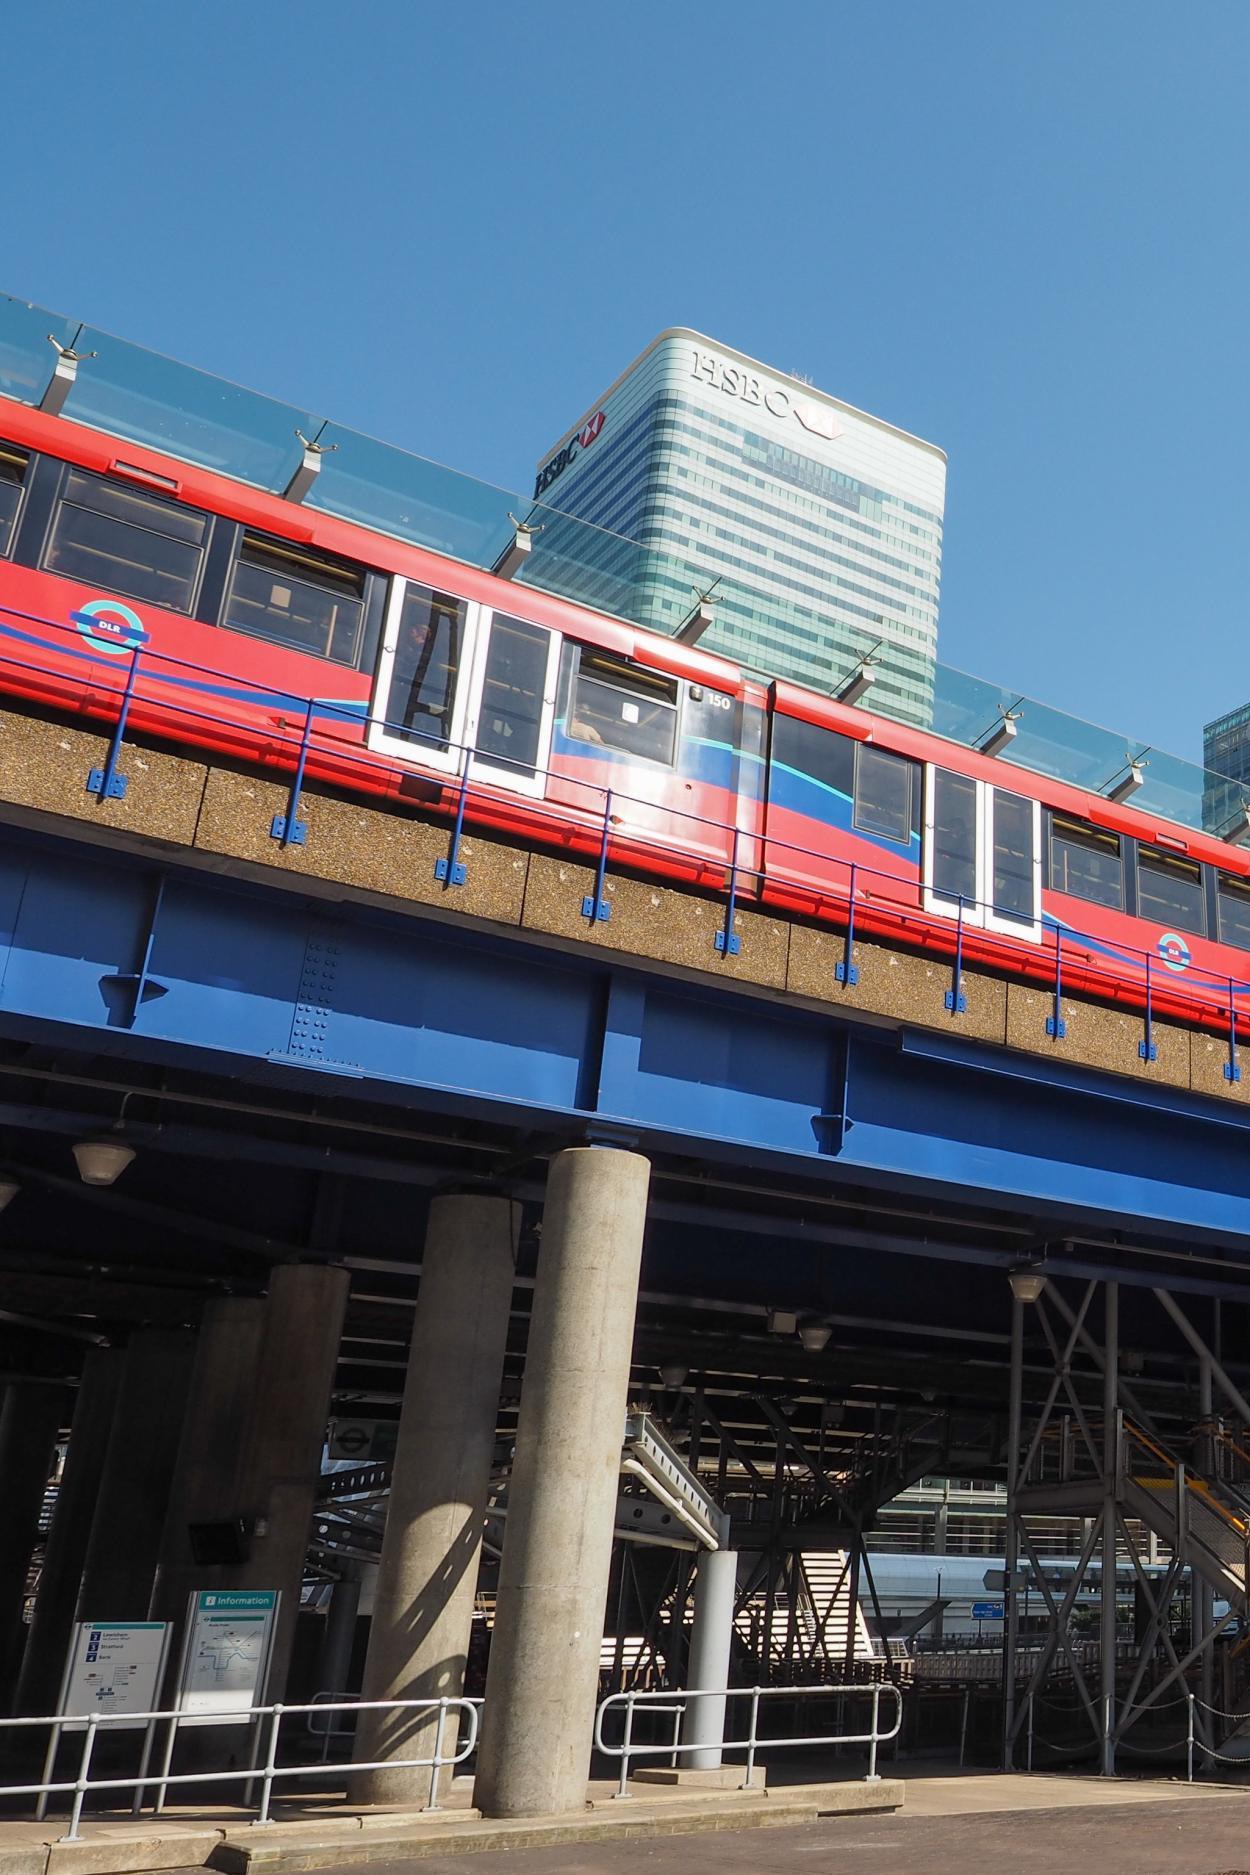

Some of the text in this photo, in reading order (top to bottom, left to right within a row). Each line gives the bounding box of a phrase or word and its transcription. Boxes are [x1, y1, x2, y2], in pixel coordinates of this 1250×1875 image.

[690, 351, 790, 418] HSBC
[533, 433, 580, 500] HSBC
[98, 620, 121, 634] DLR
[708, 693, 731, 710] 150
[218, 1597, 269, 1605] Information
